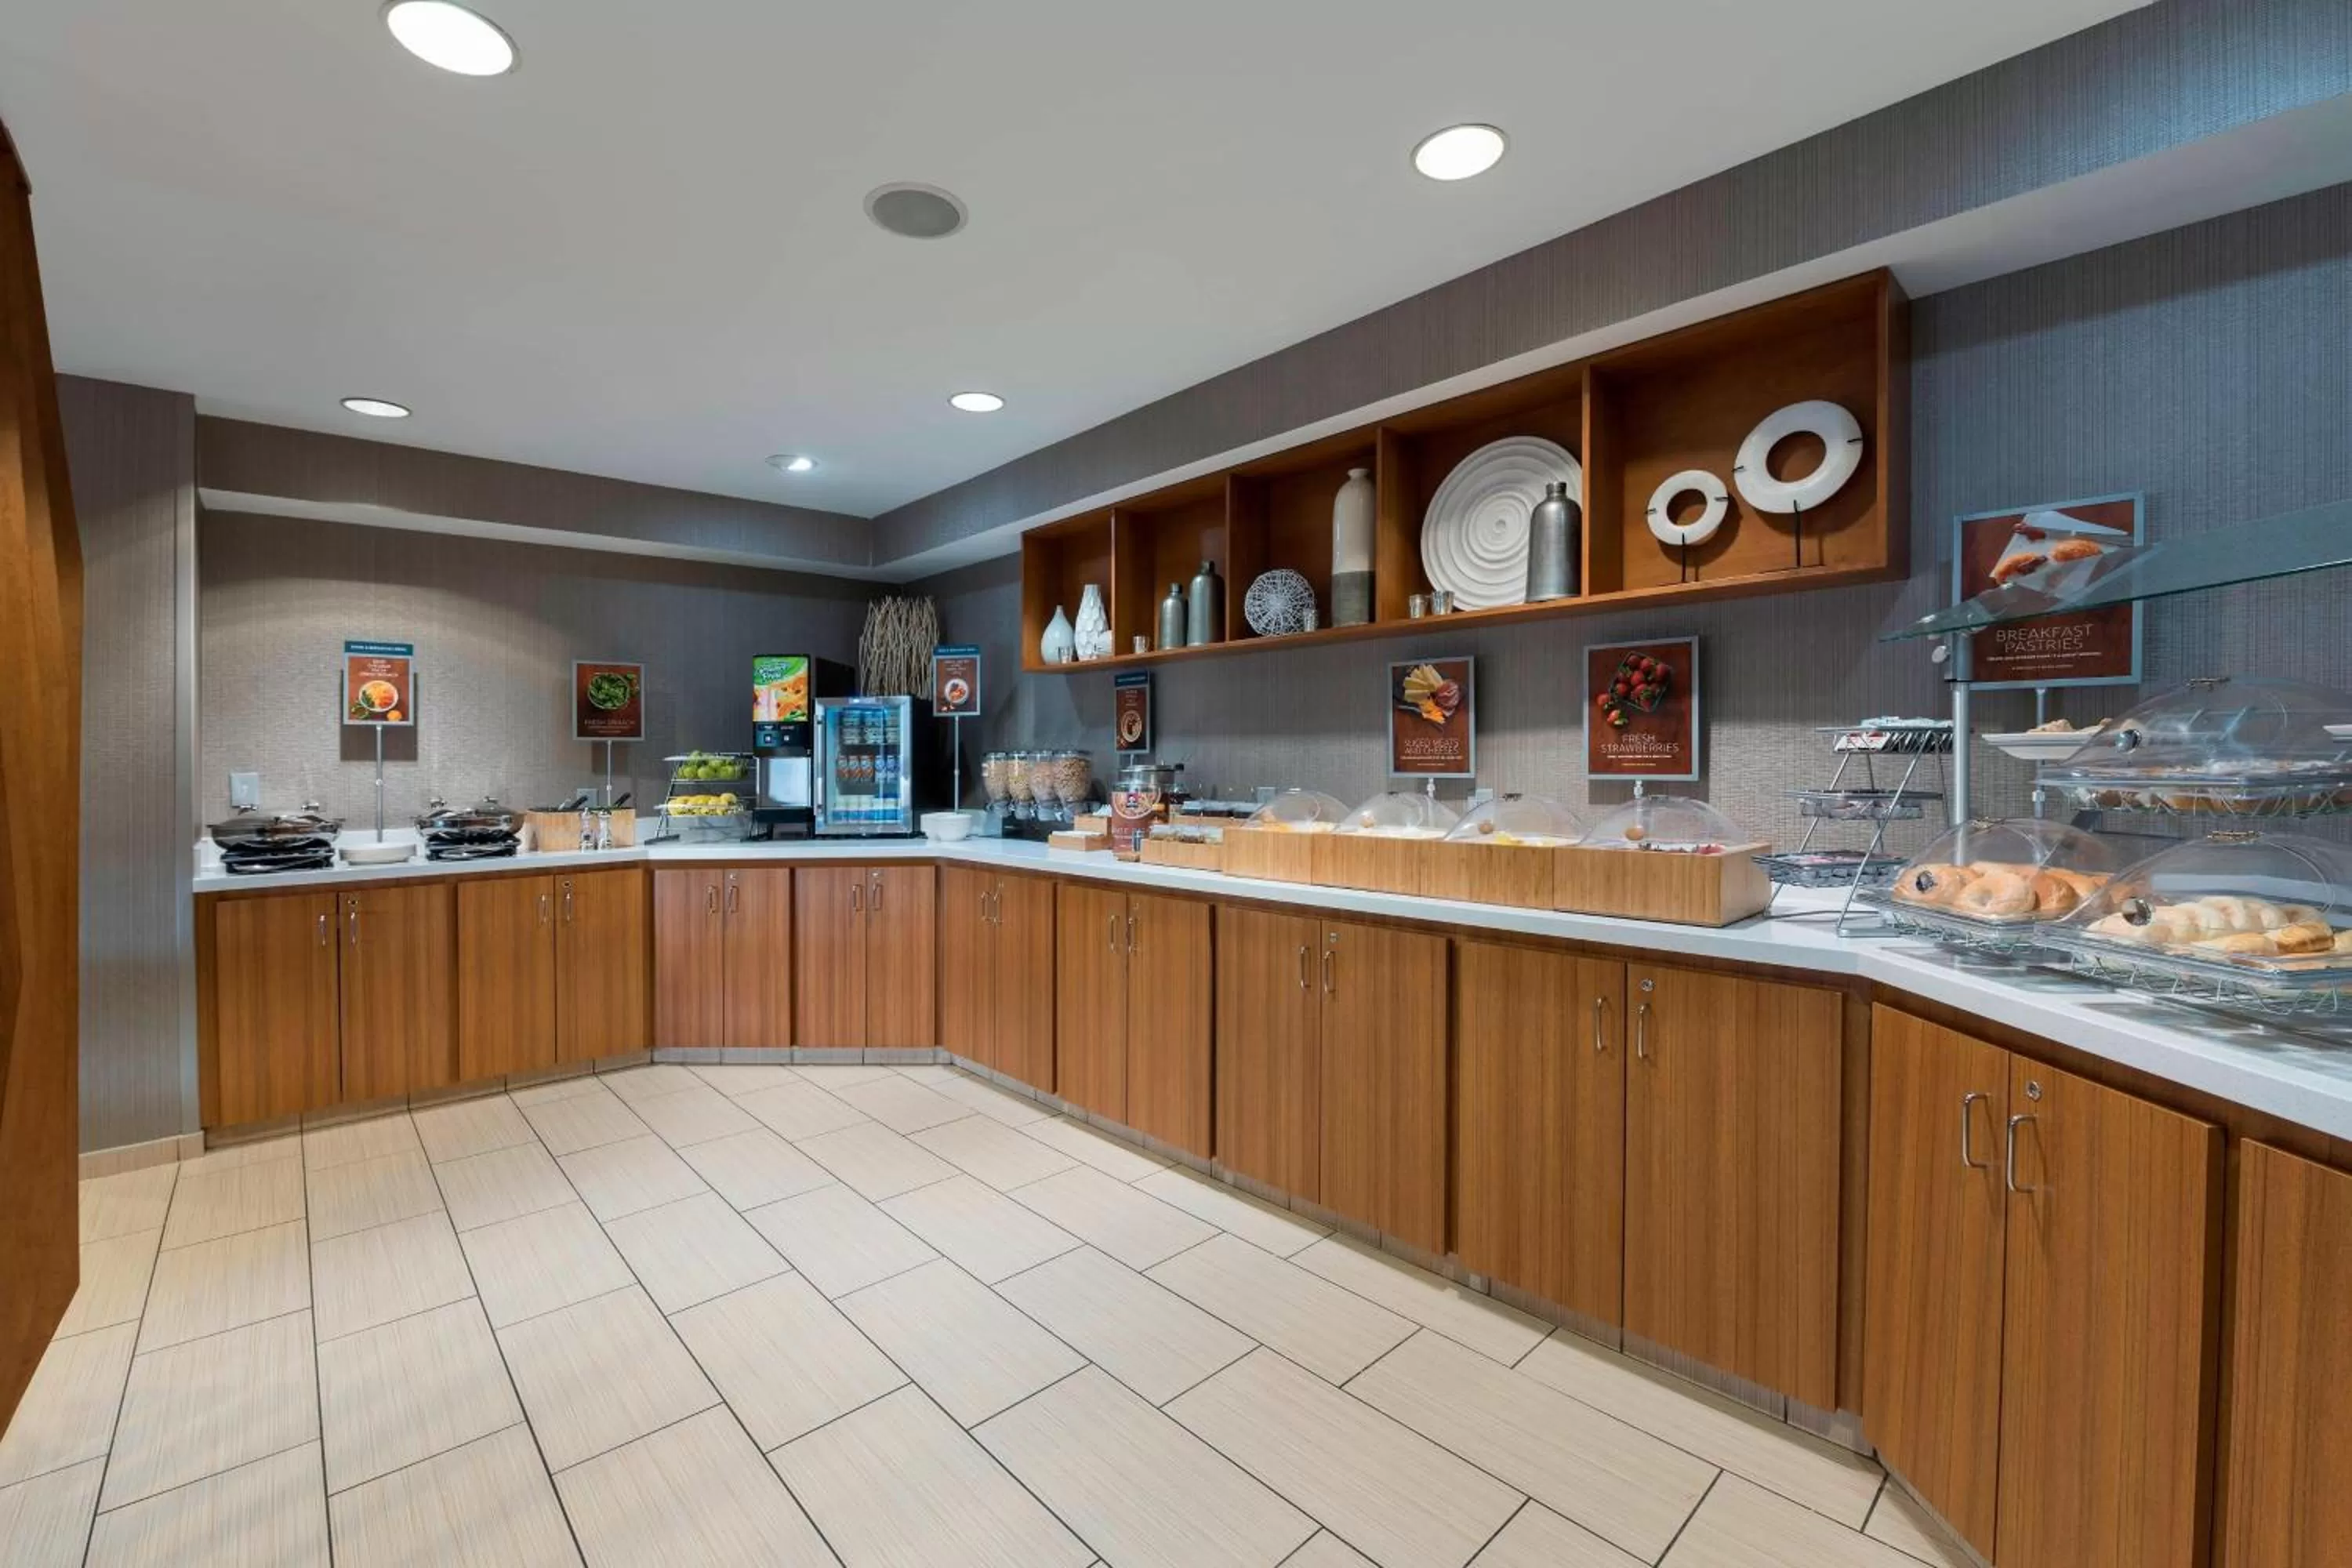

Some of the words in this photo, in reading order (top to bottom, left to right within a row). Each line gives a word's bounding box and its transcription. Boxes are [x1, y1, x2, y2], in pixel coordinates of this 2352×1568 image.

[1996, 623, 2094, 642] BREAKFAST
[2005, 637, 2083, 653] PASTRIES
[1622, 734, 1656, 743] FRESH
[1600, 742, 1679, 753] STRAWBERRIES
